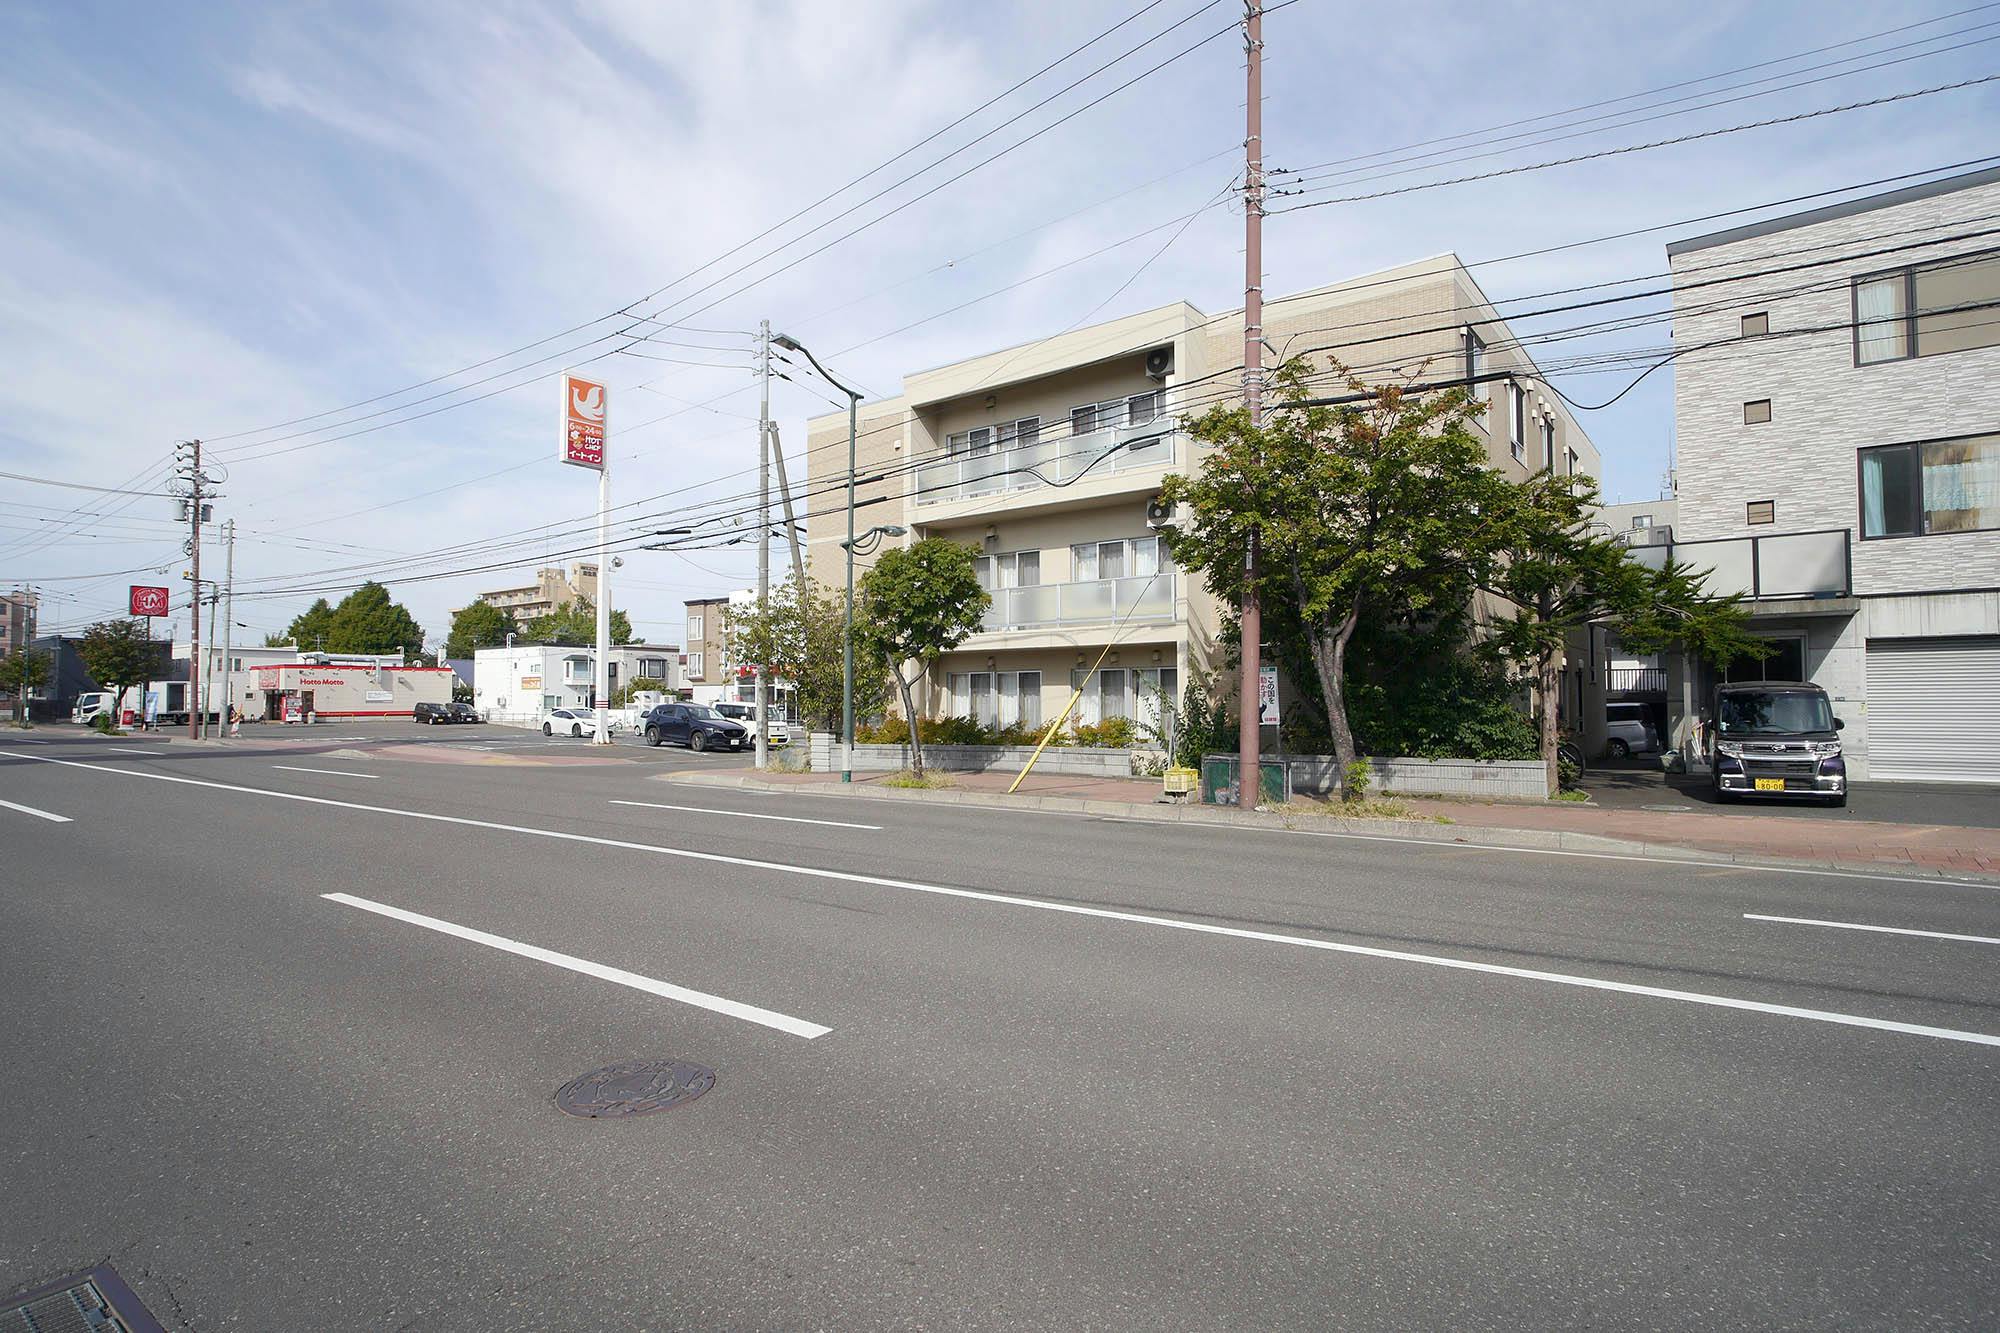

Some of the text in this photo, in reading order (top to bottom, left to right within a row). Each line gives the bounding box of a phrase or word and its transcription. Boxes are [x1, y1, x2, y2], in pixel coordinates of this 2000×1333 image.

[585, 435, 602, 445] HOT
[569, 450, 601, 463] イートイン
[322, 678, 344, 686] Motto
